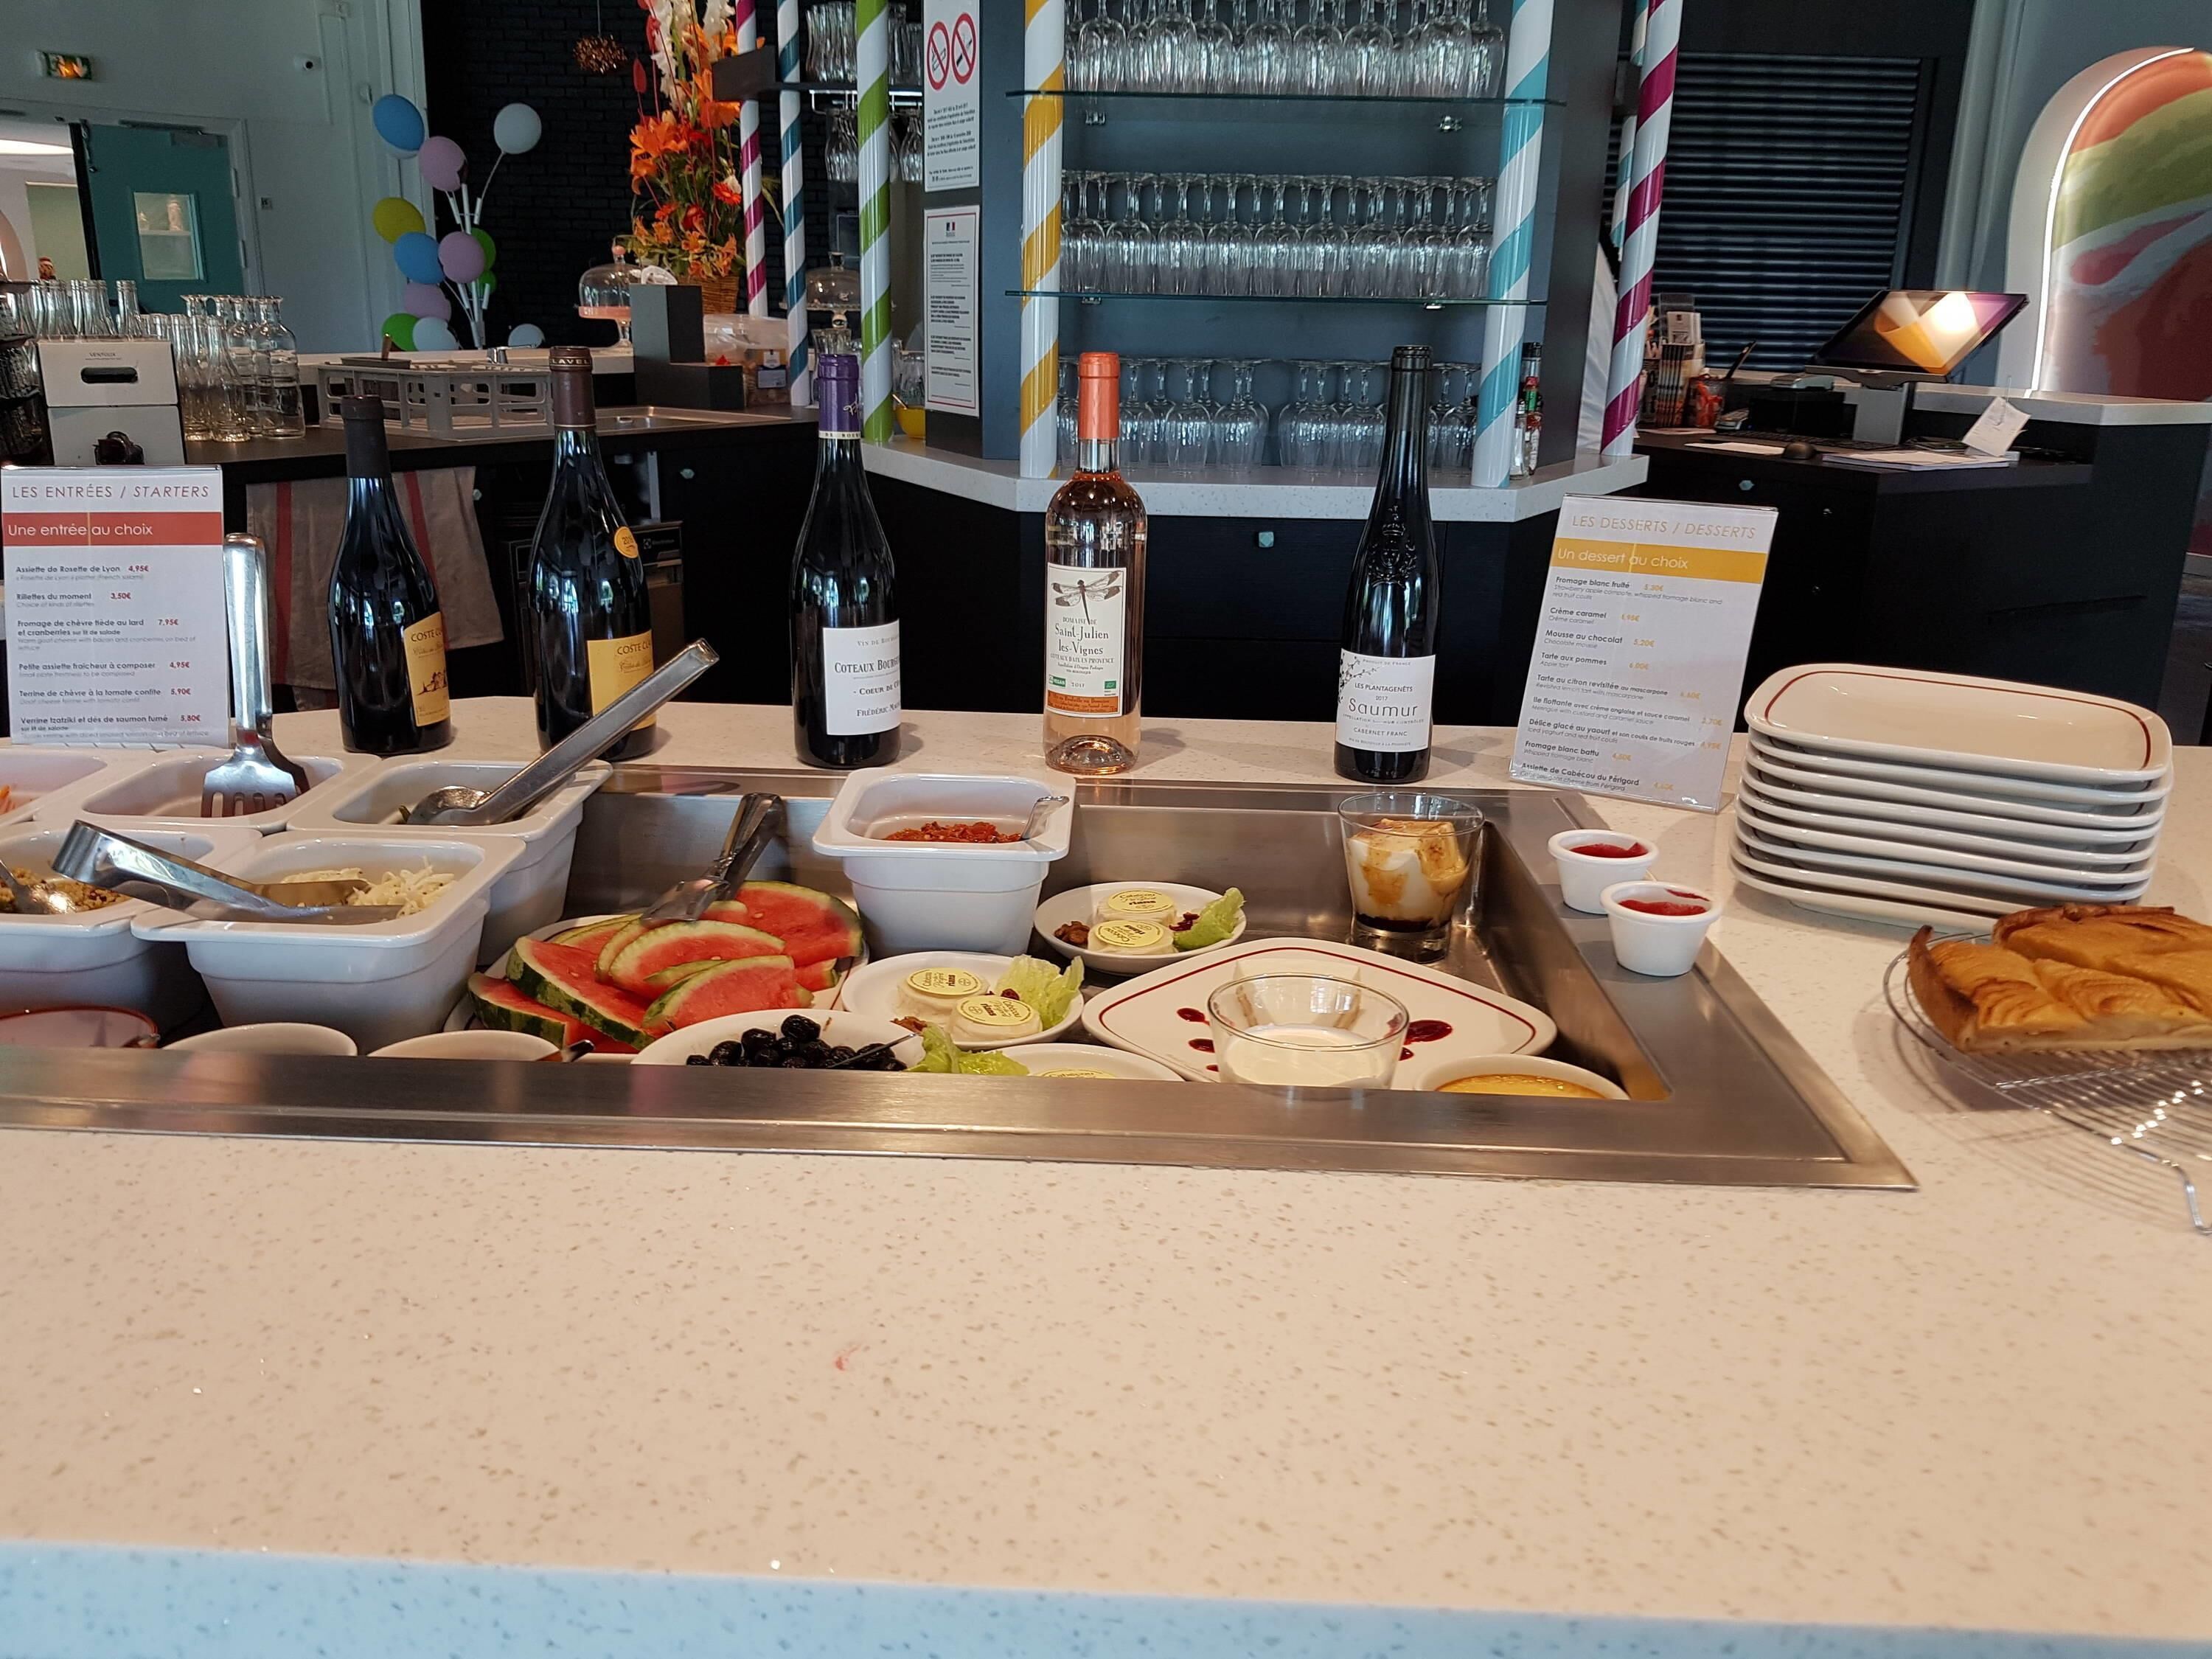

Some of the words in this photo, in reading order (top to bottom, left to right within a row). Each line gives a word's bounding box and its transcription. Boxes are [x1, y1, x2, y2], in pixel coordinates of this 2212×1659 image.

[13, 486, 38, 498] LES
[46, 484, 112, 498] ENTRÉES
[119, 486, 126, 498] /
[133, 486, 209, 498] STARTERS
[8, 524, 36, 536] Une
[41, 523, 88, 536] entrée
[91, 525, 111, 535] au
[114, 523, 153, 535] choix
[1572, 515, 1595, 528] LES
[1600, 517, 1667, 533] DESSERTS
[1672, 522, 1680, 534] /
[1684, 524, 1756, 540] DESSERTS
[1557, 548, 1575, 560] Un
[1578, 548, 1625, 564] dessert
[1629, 554, 1646, 566] au
[1651, 555, 1688, 570] choix
[128, 565, 149, 573] 4,95€
[1556, 577, 1587, 586] Fromage
[1589, 579, 1610, 588] blanc
[1612, 581, 1630, 589] fruité
[1550, 607, 1574, 616] Crème
[1576, 611, 1607, 619] caramel
[18, 620, 52, 628] Fromage
[66, 619, 93, 627] chèvre
[1062, 616, 1086, 625] DOMAINE
[411, 629, 434, 642] COSTE
[1055, 622, 1109, 641] Saint-Julien
[1545, 629, 1574, 639] Mousse
[1587, 635, 1623, 644] chocolat
[617, 643, 641, 655] COSTE
[1059, 639, 1104, 656] les-Vignes
[1542, 652, 1559, 660] Tarte
[1575, 656, 1607, 666] pommes
[835, 662, 874, 673] COTEAUX
[859, 686, 884, 695] COEUR
[1365, 684, 1413, 692] PLANTAGENÊTS
[1537, 674, 1554, 682] Tarte
[1567, 678, 1587, 686] citron
[1588, 681, 1619, 690] revisitée
[1630, 686, 1668, 696] mascarpone
[857, 706, 888, 717] FRÉDÉRIC
[1349, 698, 1418, 717] Saumur
[1543, 697, 1573, 707] flottante
[1610, 706, 1635, 716] anglaise
[1663, 714, 1690, 723] caramel
[148, 714, 168, 722] fumé
[1354, 727, 1385, 736] CABERNET
[1529, 718, 1552, 727] Délice
[1553, 721, 1574, 730] glacé
[1587, 726, 1611, 736] yaourt
[1630, 732, 1648, 740] coulis
[1674, 739, 1695, 748] rouges
[1525, 740, 1557, 751] Fromage
[1557, 745, 1579, 754] blanc
[1580, 748, 1600, 757] battu
[1521, 762, 1548, 773] Assiette
[1561, 768, 1596, 779] Cabécou
[1596, 773, 1607, 781] du
[1608, 774, 1640, 787] Périgord
